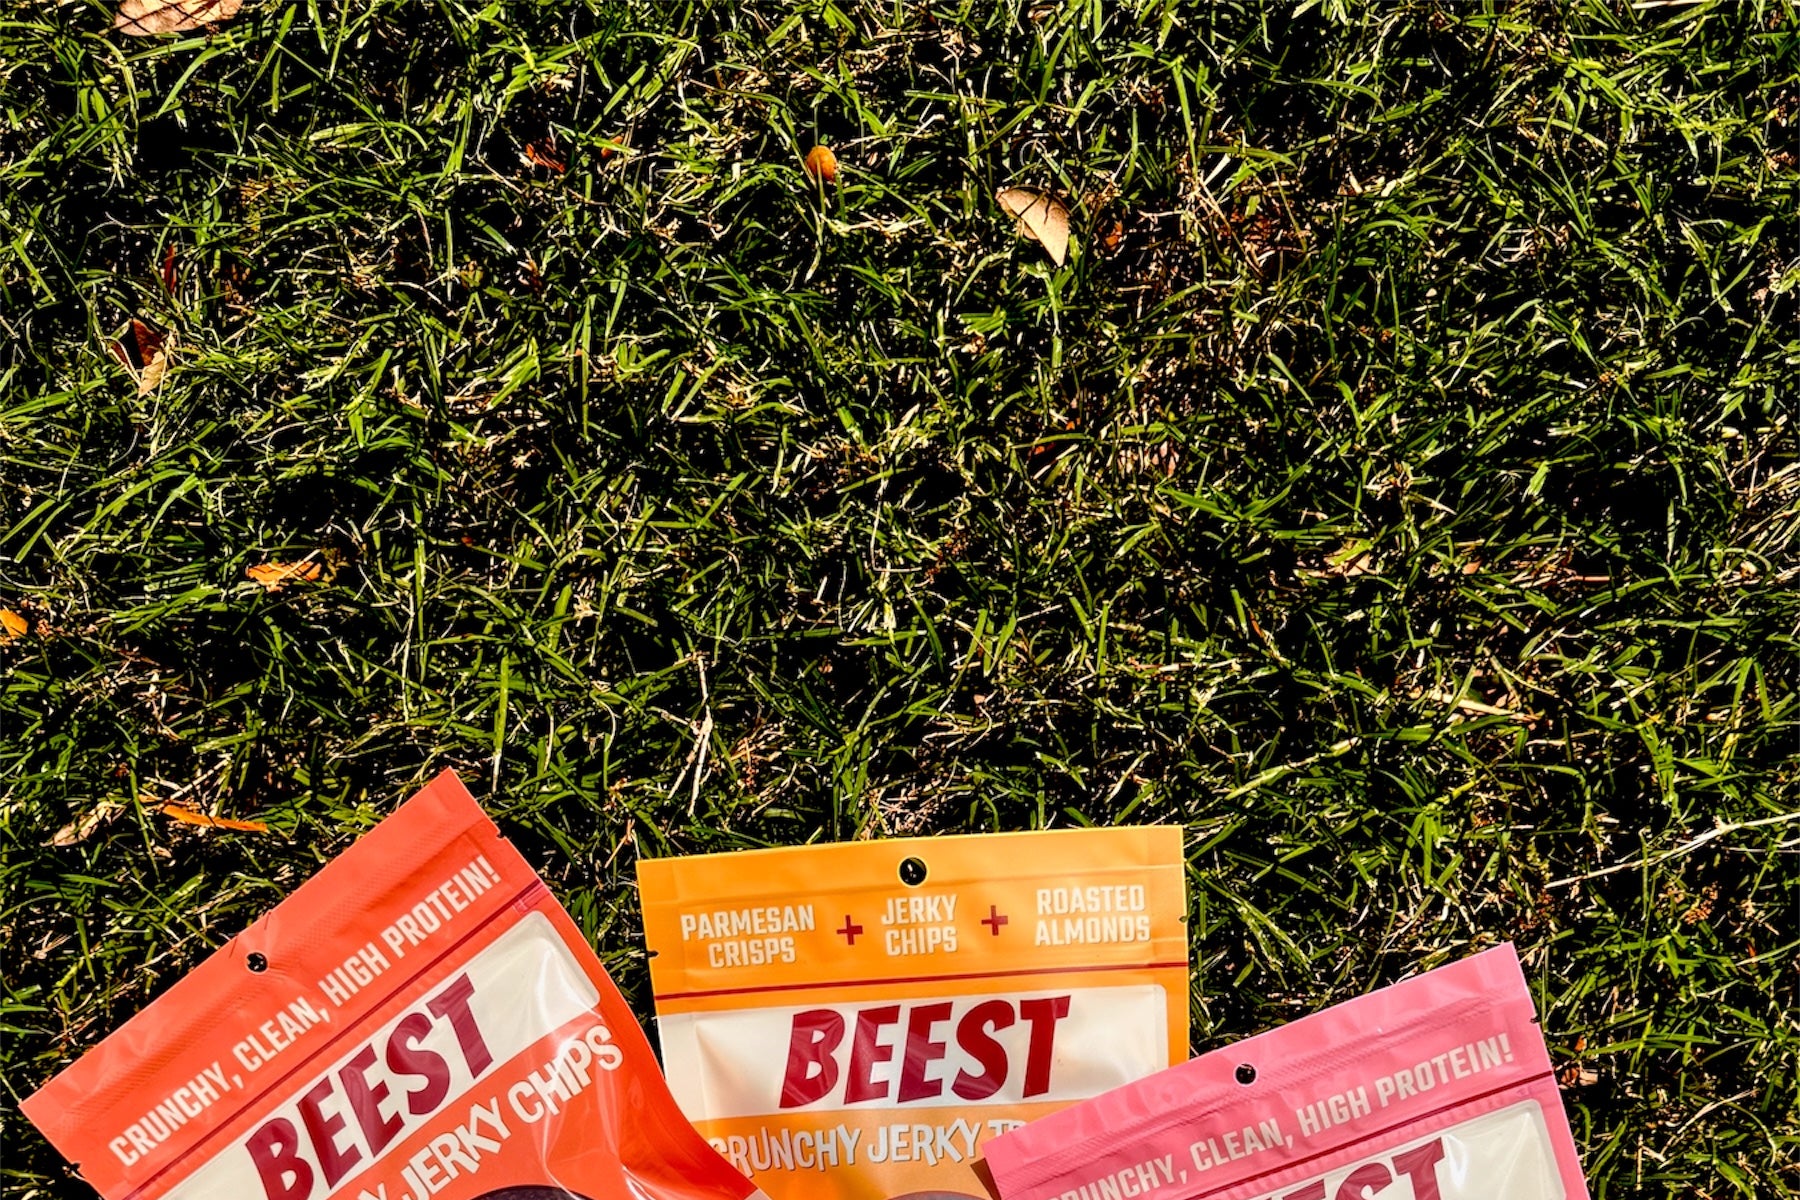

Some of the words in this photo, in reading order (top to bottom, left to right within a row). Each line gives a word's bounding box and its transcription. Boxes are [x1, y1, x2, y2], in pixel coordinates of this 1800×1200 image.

[881, 894, 957, 926] JERKY
[1036, 884, 1145, 916] ROASTED
[680, 904, 815, 941] PARMESAN
[1034, 915, 1150, 946] ALMONDS
[709, 937, 796, 969] CRISPS
[885, 926, 957, 957] CHIPS
[108, 1061, 244, 1167] CRUNCHY,
[232, 995, 332, 1073] CLEAN,
[317, 943, 391, 1007] HIGH
[381, 854, 501, 959] PROTEIN!
[779, 995, 1071, 1109] BEEST
[508, 1025, 623, 1123] CHIPS
[1189, 1117, 1294, 1173] CLEAN,
[1295, 1087, 1371, 1138] HIGH
[1374, 1032, 1515, 1108] PROTEIN!
[867, 1117, 981, 1167] JERKY
